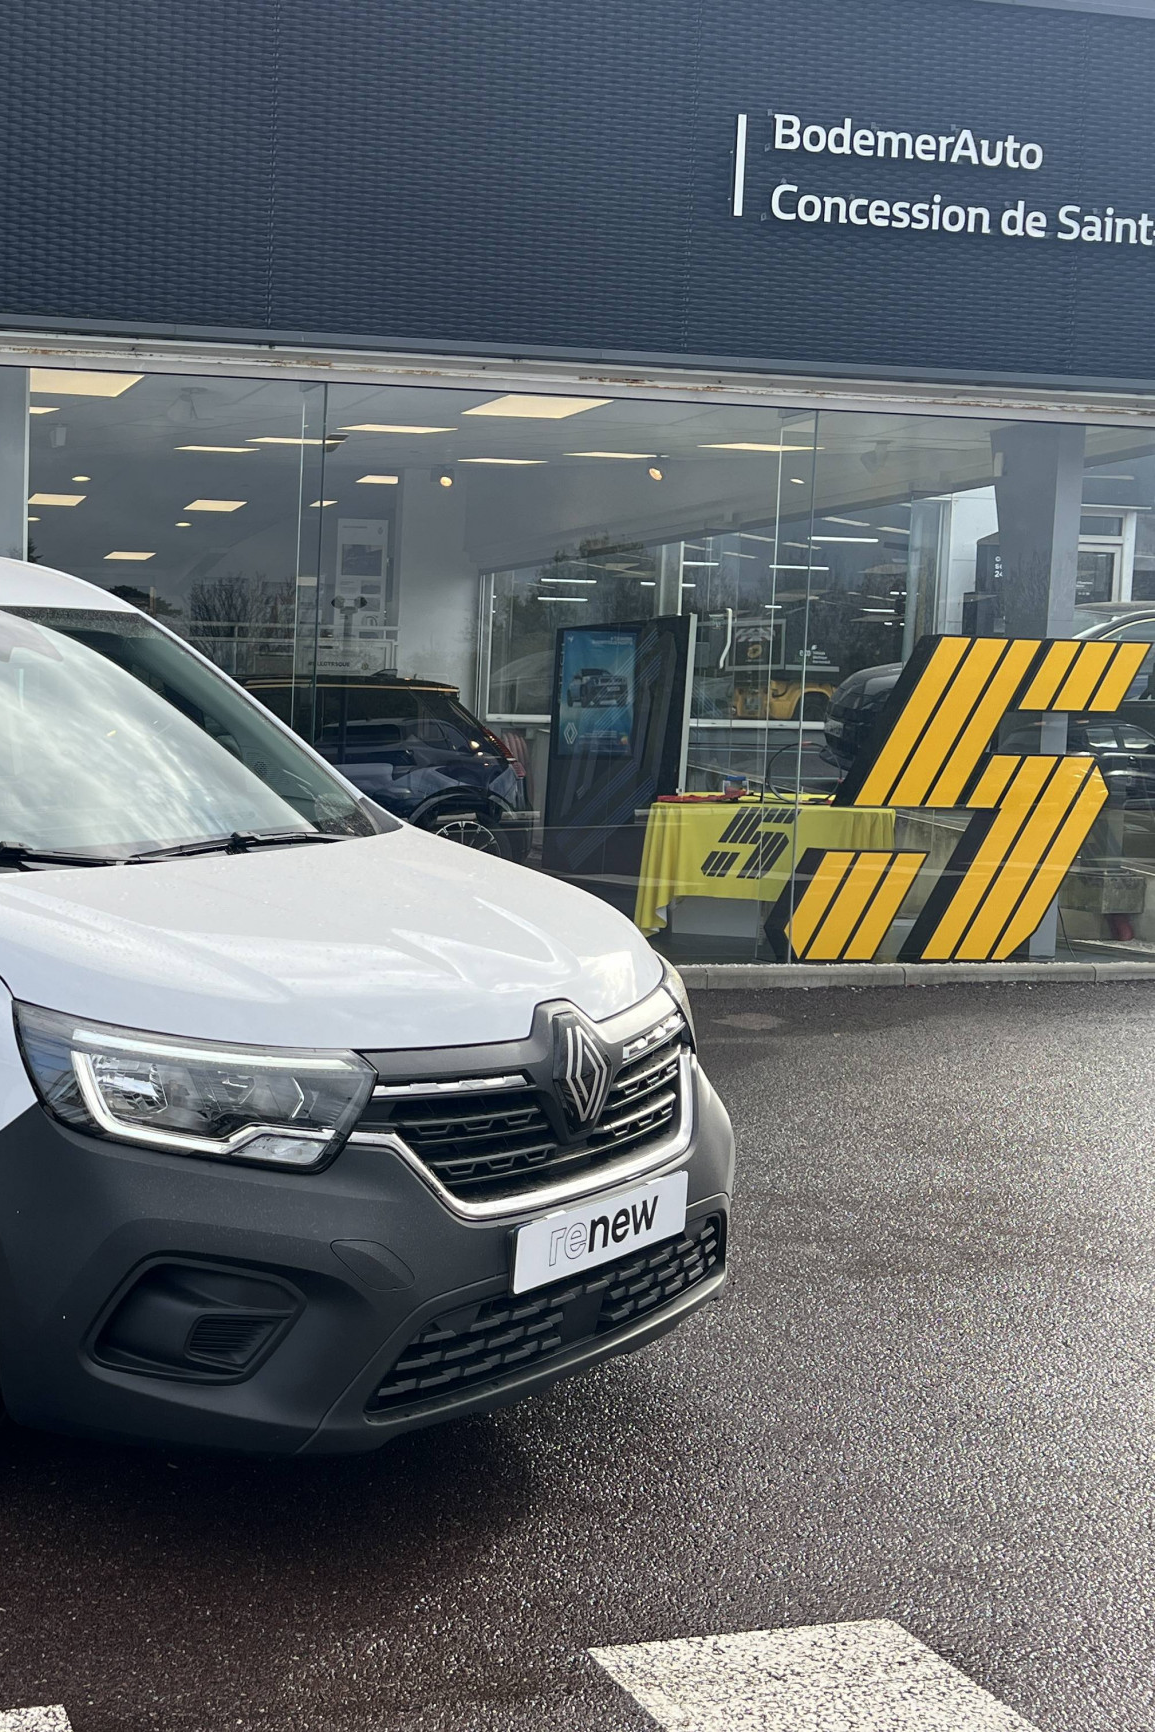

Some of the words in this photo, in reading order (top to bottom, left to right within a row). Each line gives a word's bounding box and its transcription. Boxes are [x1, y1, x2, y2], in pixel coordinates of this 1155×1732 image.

[773, 113, 1044, 170] BodemerAuto
[770, 184, 991, 235] Concession
[1000, 201, 1046, 238] de
[1057, 204, 1155, 246] Saint
[548, 1194, 659, 1268] renew
